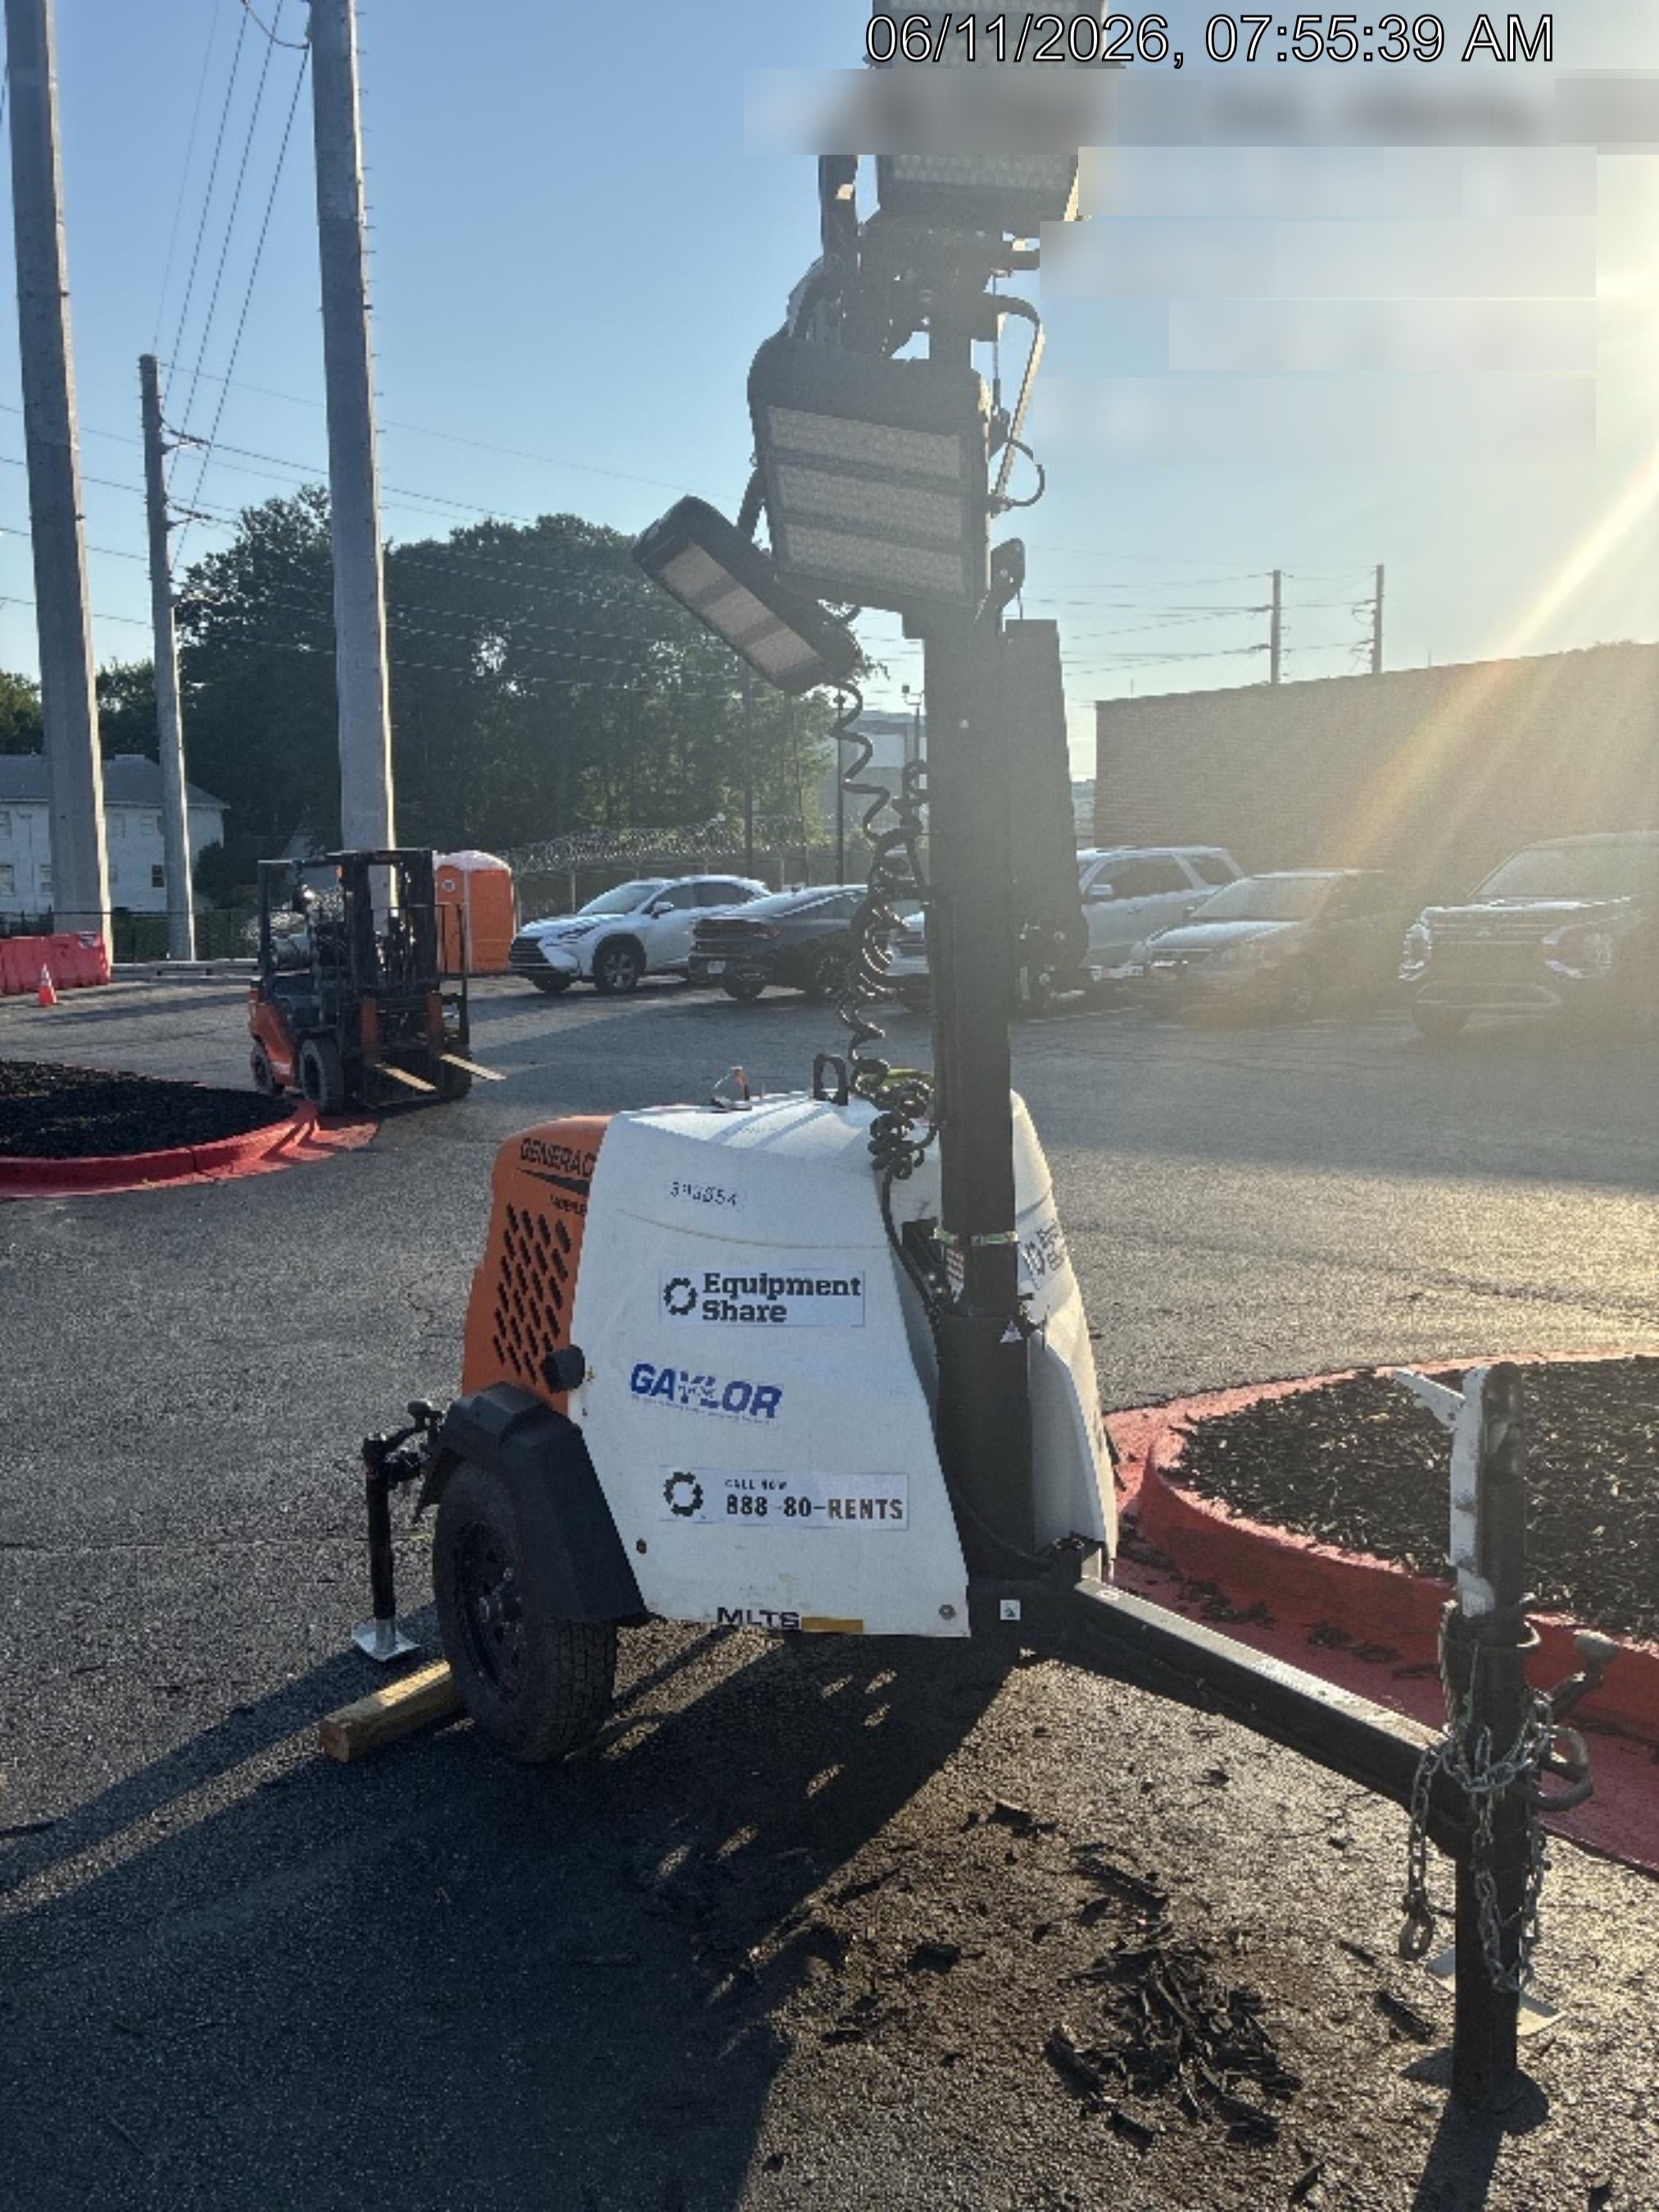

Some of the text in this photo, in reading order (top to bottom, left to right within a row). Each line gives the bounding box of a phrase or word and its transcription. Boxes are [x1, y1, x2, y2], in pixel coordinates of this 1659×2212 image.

[520, 1137, 597, 1176] GENERAC
[702, 1272, 862, 1301] Equipment
[702, 1299, 787, 1323] Share
[630, 1362, 782, 1419] GAYLOR
[724, 1479, 755, 1490] CALL
[716, 1606, 800, 1631] MLTS
